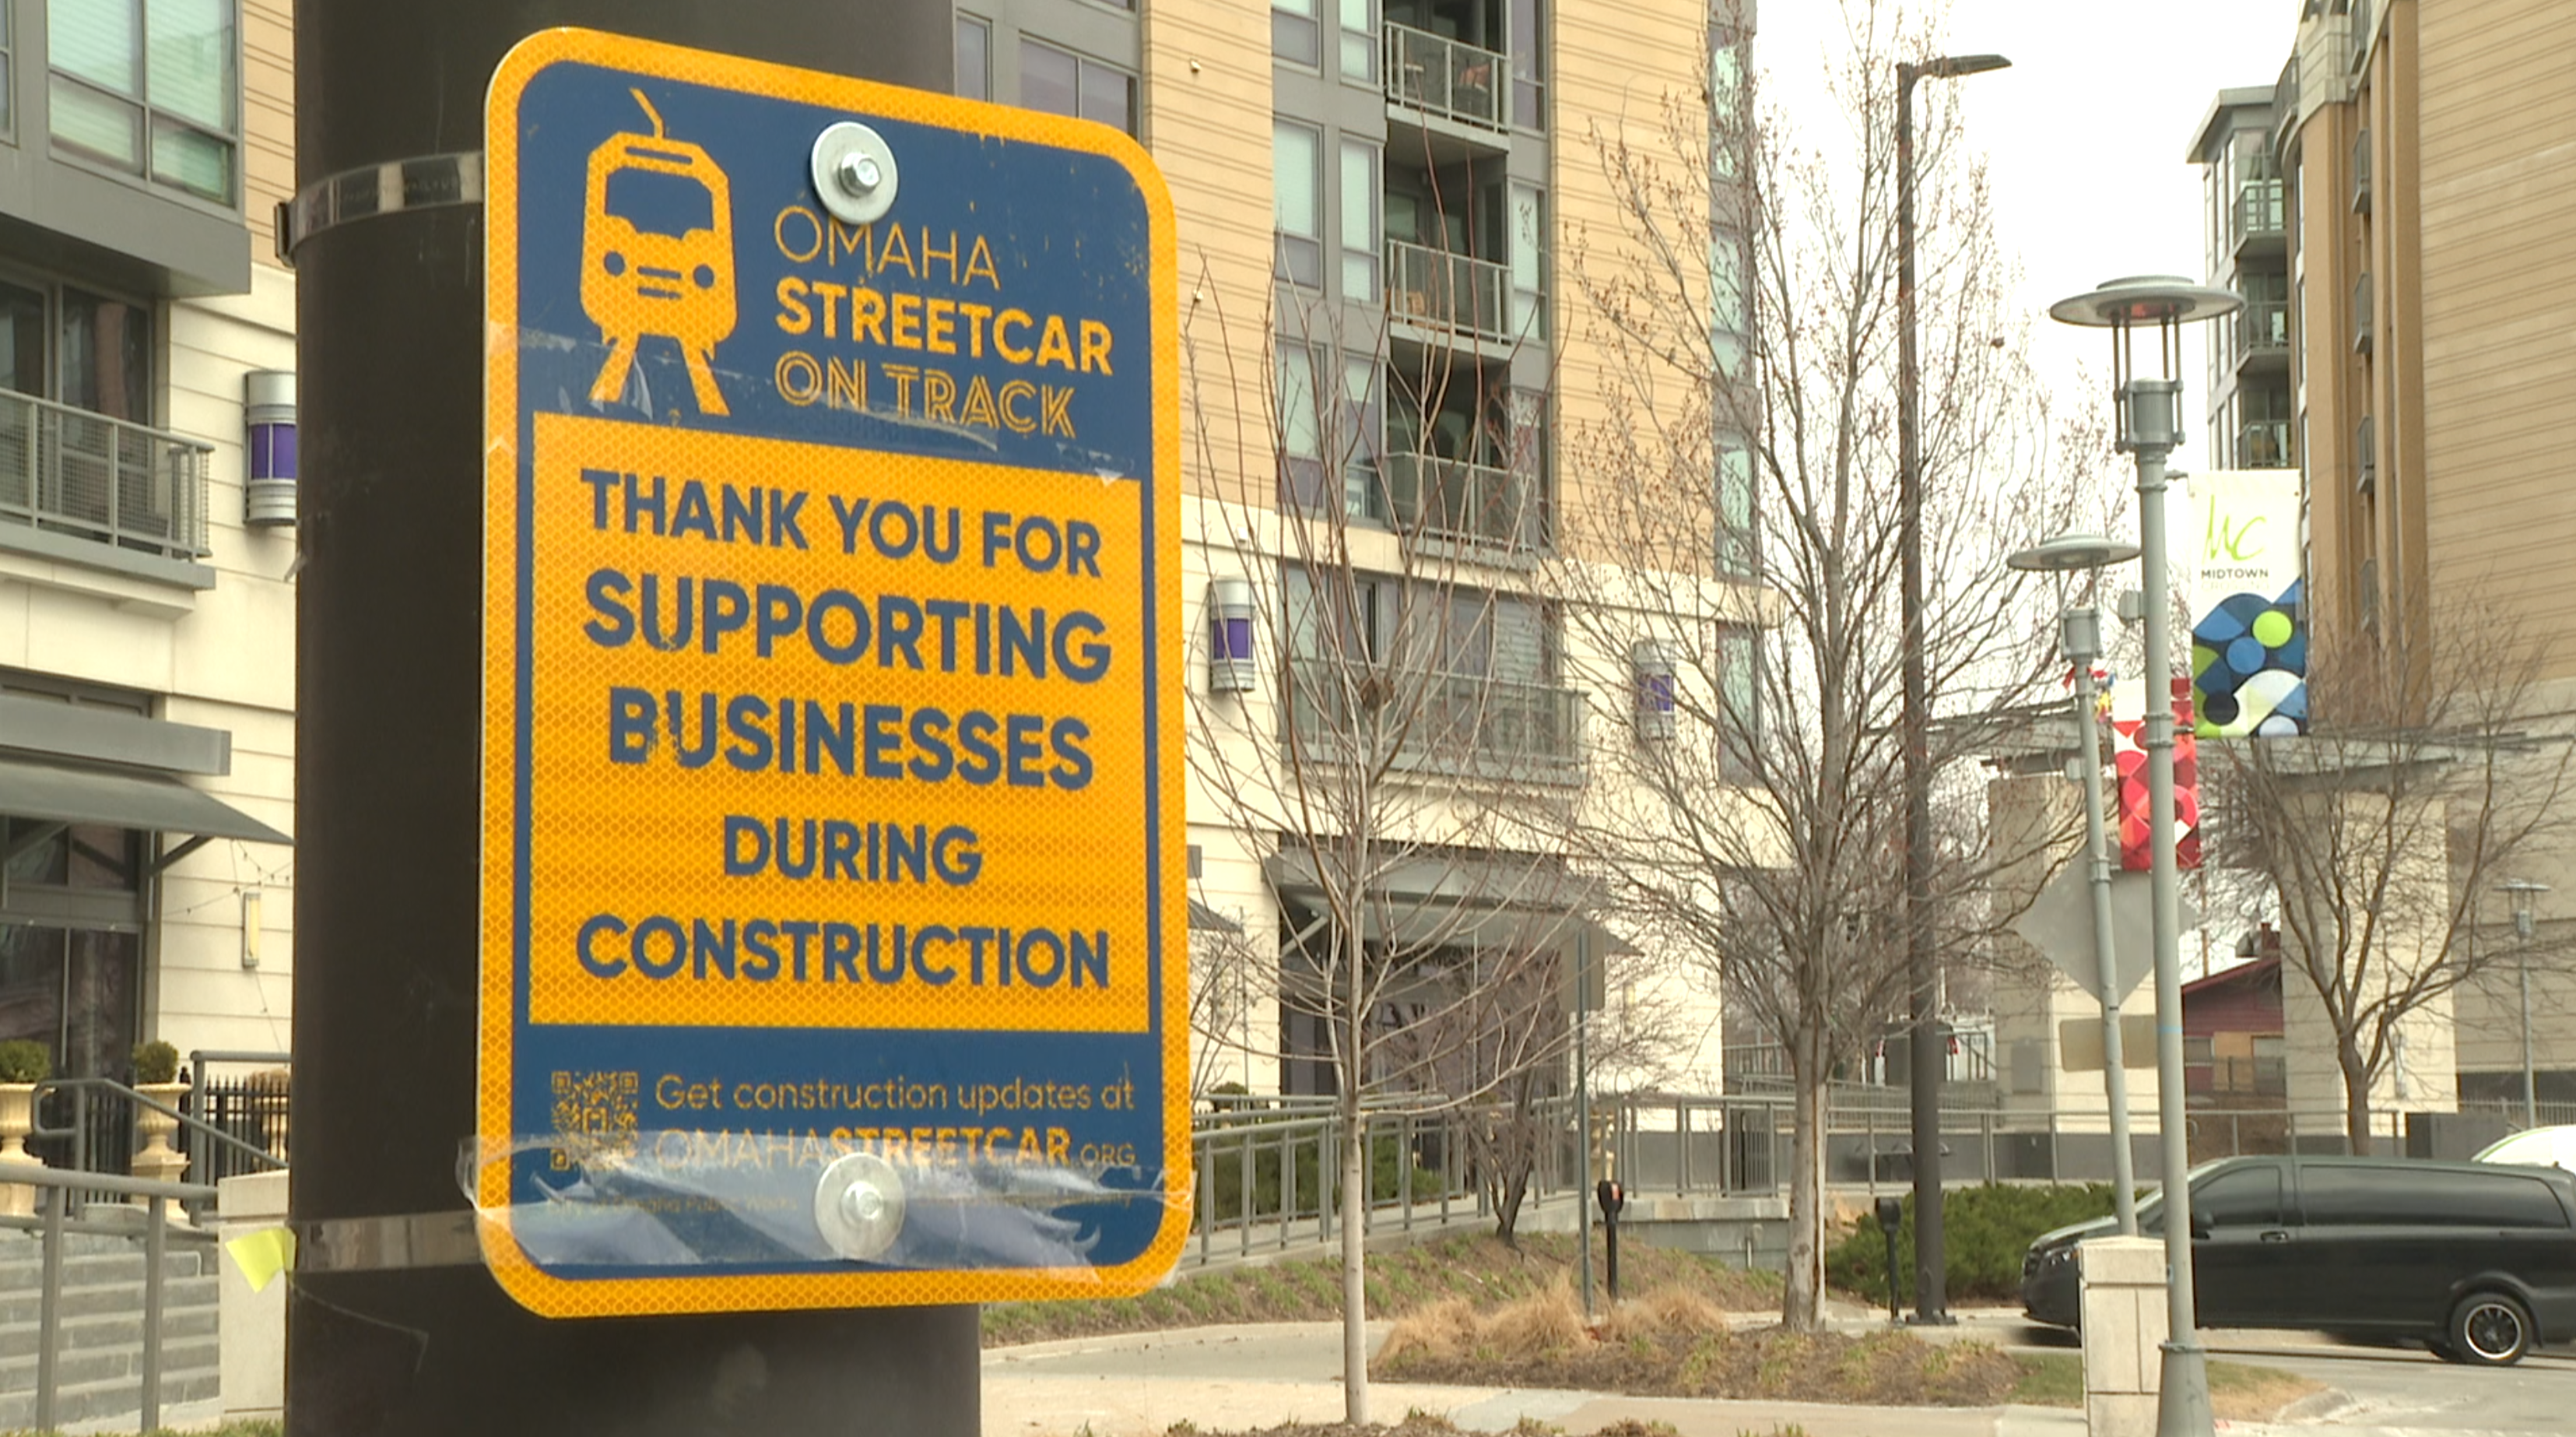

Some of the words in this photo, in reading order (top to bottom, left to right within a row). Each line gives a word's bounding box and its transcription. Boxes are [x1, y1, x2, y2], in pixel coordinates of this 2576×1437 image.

[774, 206, 1001, 290] OMAHA
[776, 276, 1113, 376] STREETCAR
[774, 350, 867, 413] ON
[880, 362, 1076, 438] TRACK
[581, 468, 809, 550] THANK
[827, 494, 960, 564] YOU
[982, 511, 1101, 578] FOR
[2201, 568, 2269, 579] MIDTOWN
[583, 568, 1111, 683] SUPPORTING
[609, 686, 1093, 790] BUSINESSES
[723, 814, 982, 885] DURING
[577, 913, 1110, 988] CONSTRUCTION
[655, 1074, 723, 1110] Get
[733, 1075, 948, 1110] construction
[957, 1074, 1091, 1116] updates
[1100, 1079, 1135, 1109] at
